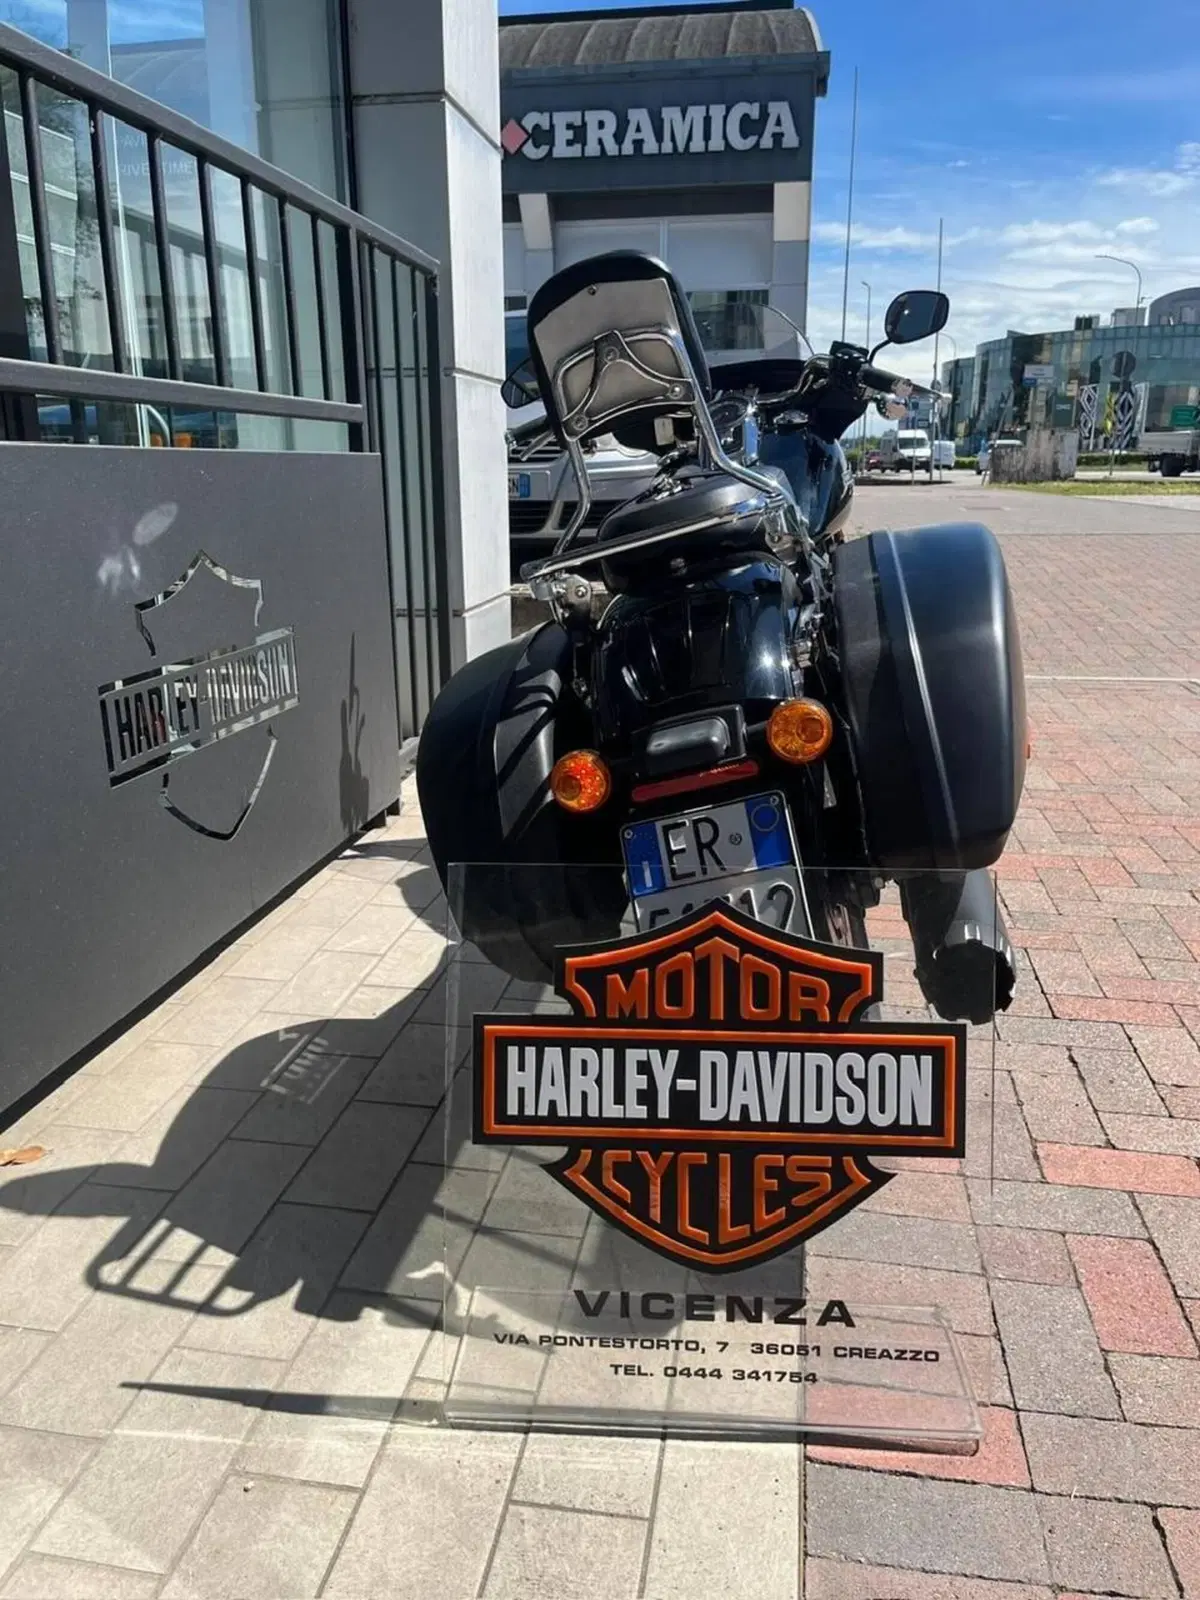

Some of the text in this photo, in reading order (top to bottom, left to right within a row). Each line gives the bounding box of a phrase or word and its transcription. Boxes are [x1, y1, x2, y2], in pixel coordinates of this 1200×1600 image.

[520, 101, 800, 160] CERAMICA
[114, 643, 292, 763] HARLEY-DAVIDSON
[662, 816, 727, 881] ER
[606, 937, 830, 1022] MOTOR
[506, 1045, 932, 1127] HARLEY-DAVIDSON
[602, 1149, 832, 1245] CYCLES
[573, 1289, 857, 1328] VICENZA
[494, 1333, 940, 1362] VIA PONTESTORTO, 7 36051 CREAZZO
[610, 1364, 818, 1384] TEL. 0444 341754
